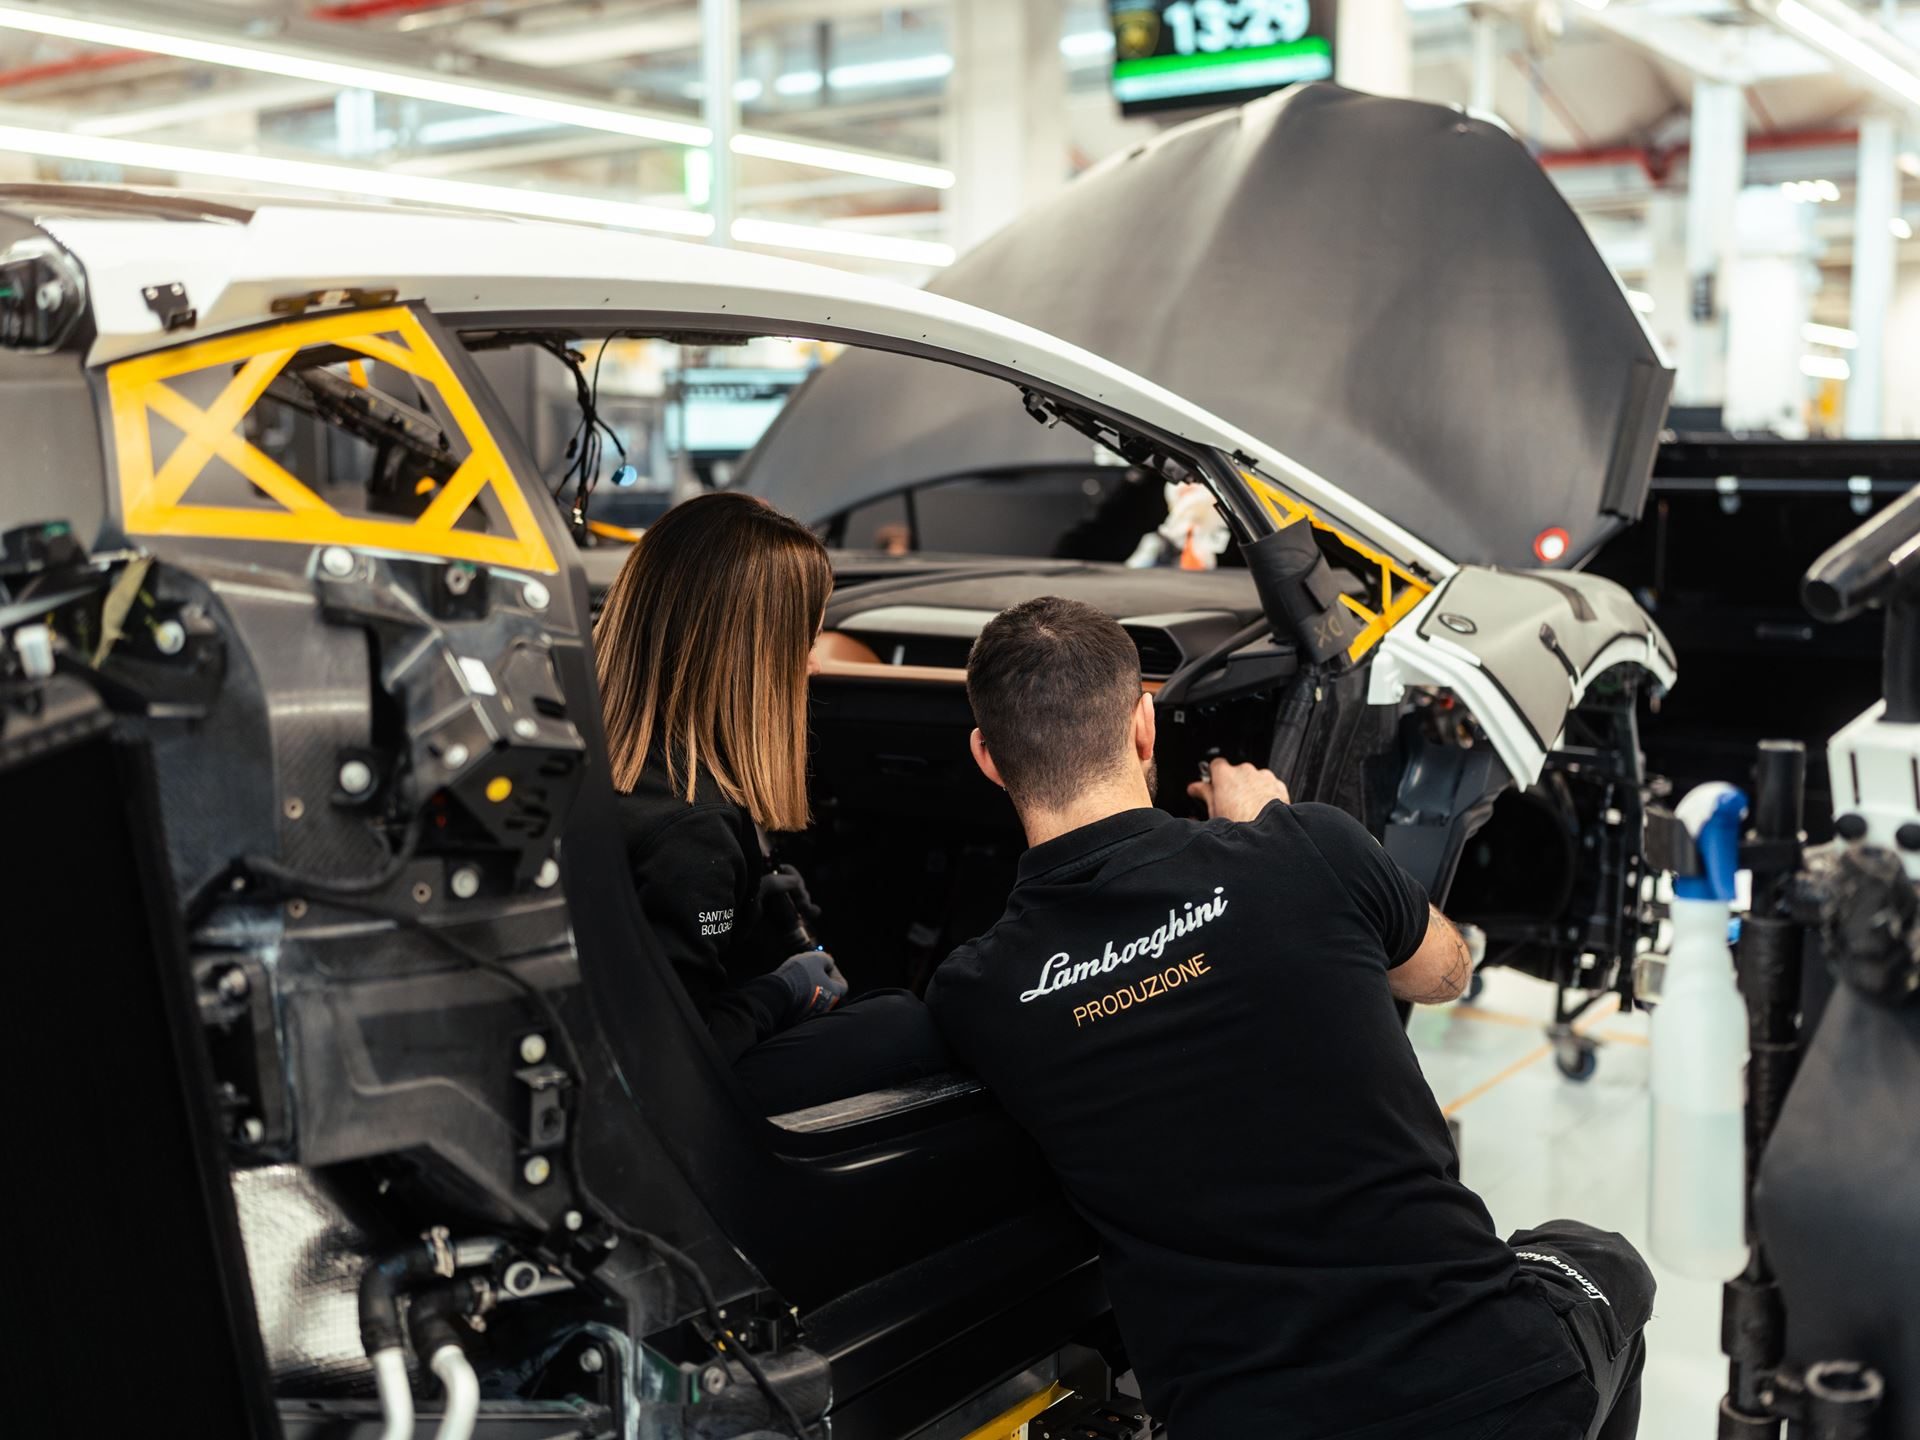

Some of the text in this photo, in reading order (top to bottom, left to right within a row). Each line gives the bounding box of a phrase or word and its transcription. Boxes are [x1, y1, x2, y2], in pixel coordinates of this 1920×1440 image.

[1019, 886, 1229, 1003] Lamborghini
[1072, 952, 1212, 1027] PRODUZIONE
[1515, 1251, 1610, 1306] Lamborghin
